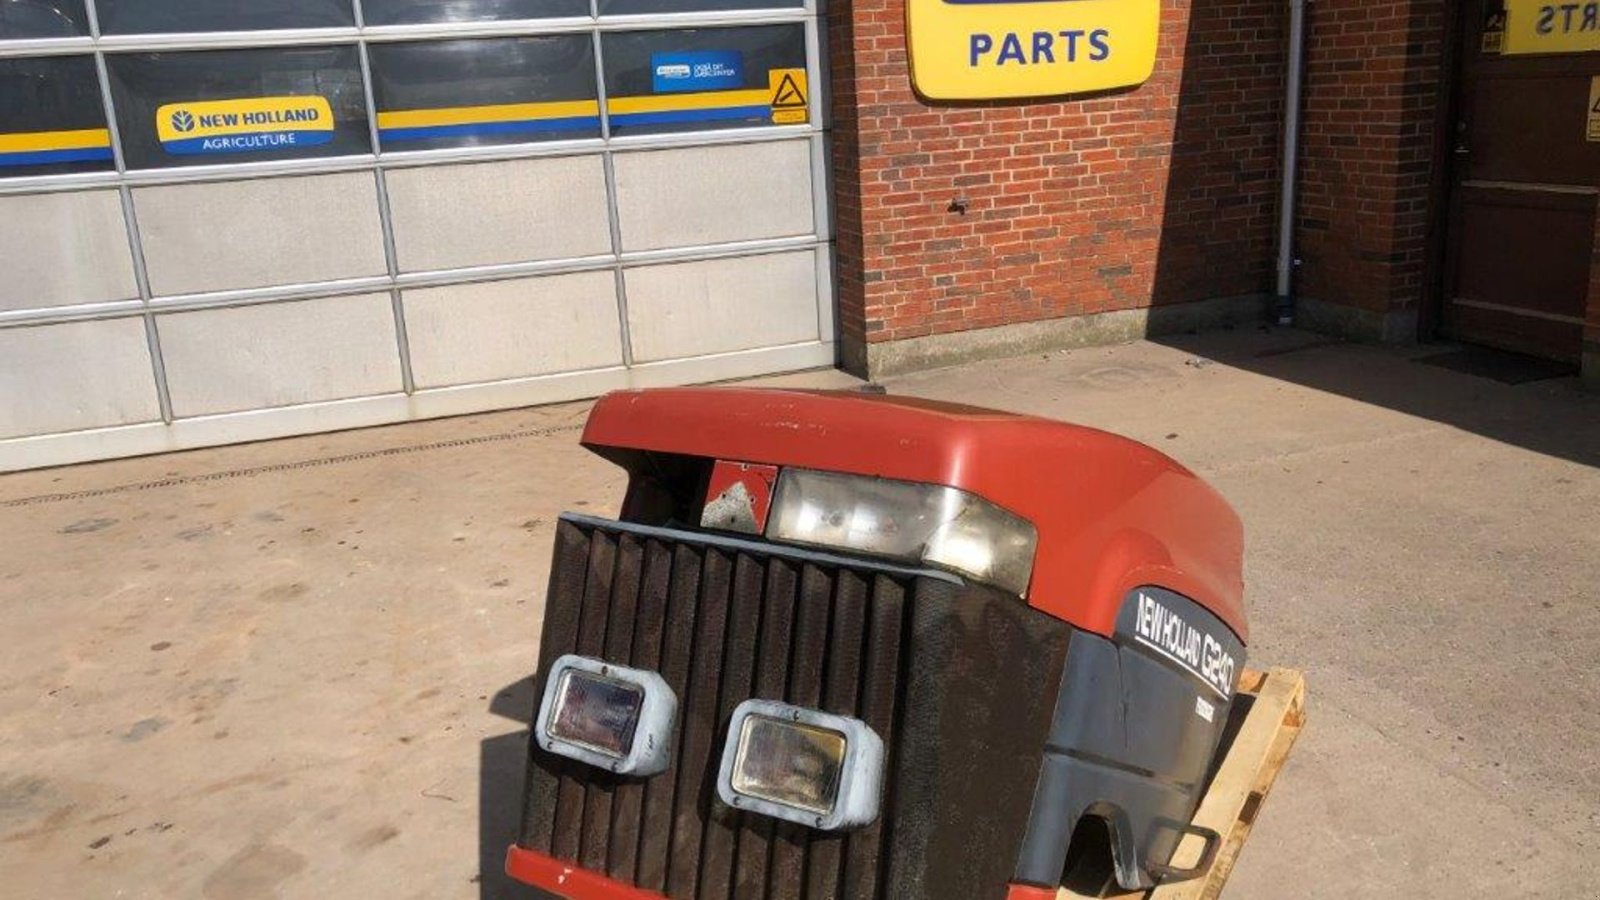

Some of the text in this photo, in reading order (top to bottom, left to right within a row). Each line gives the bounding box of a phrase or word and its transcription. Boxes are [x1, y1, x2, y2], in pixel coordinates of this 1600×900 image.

[969, 29, 1110, 67] PARTS
[199, 108, 319, 128] NEW HOLLAND
[202, 132, 296, 150] AGRICULTURE
[1135, 592, 1234, 695] NEW HOLLAND G240
